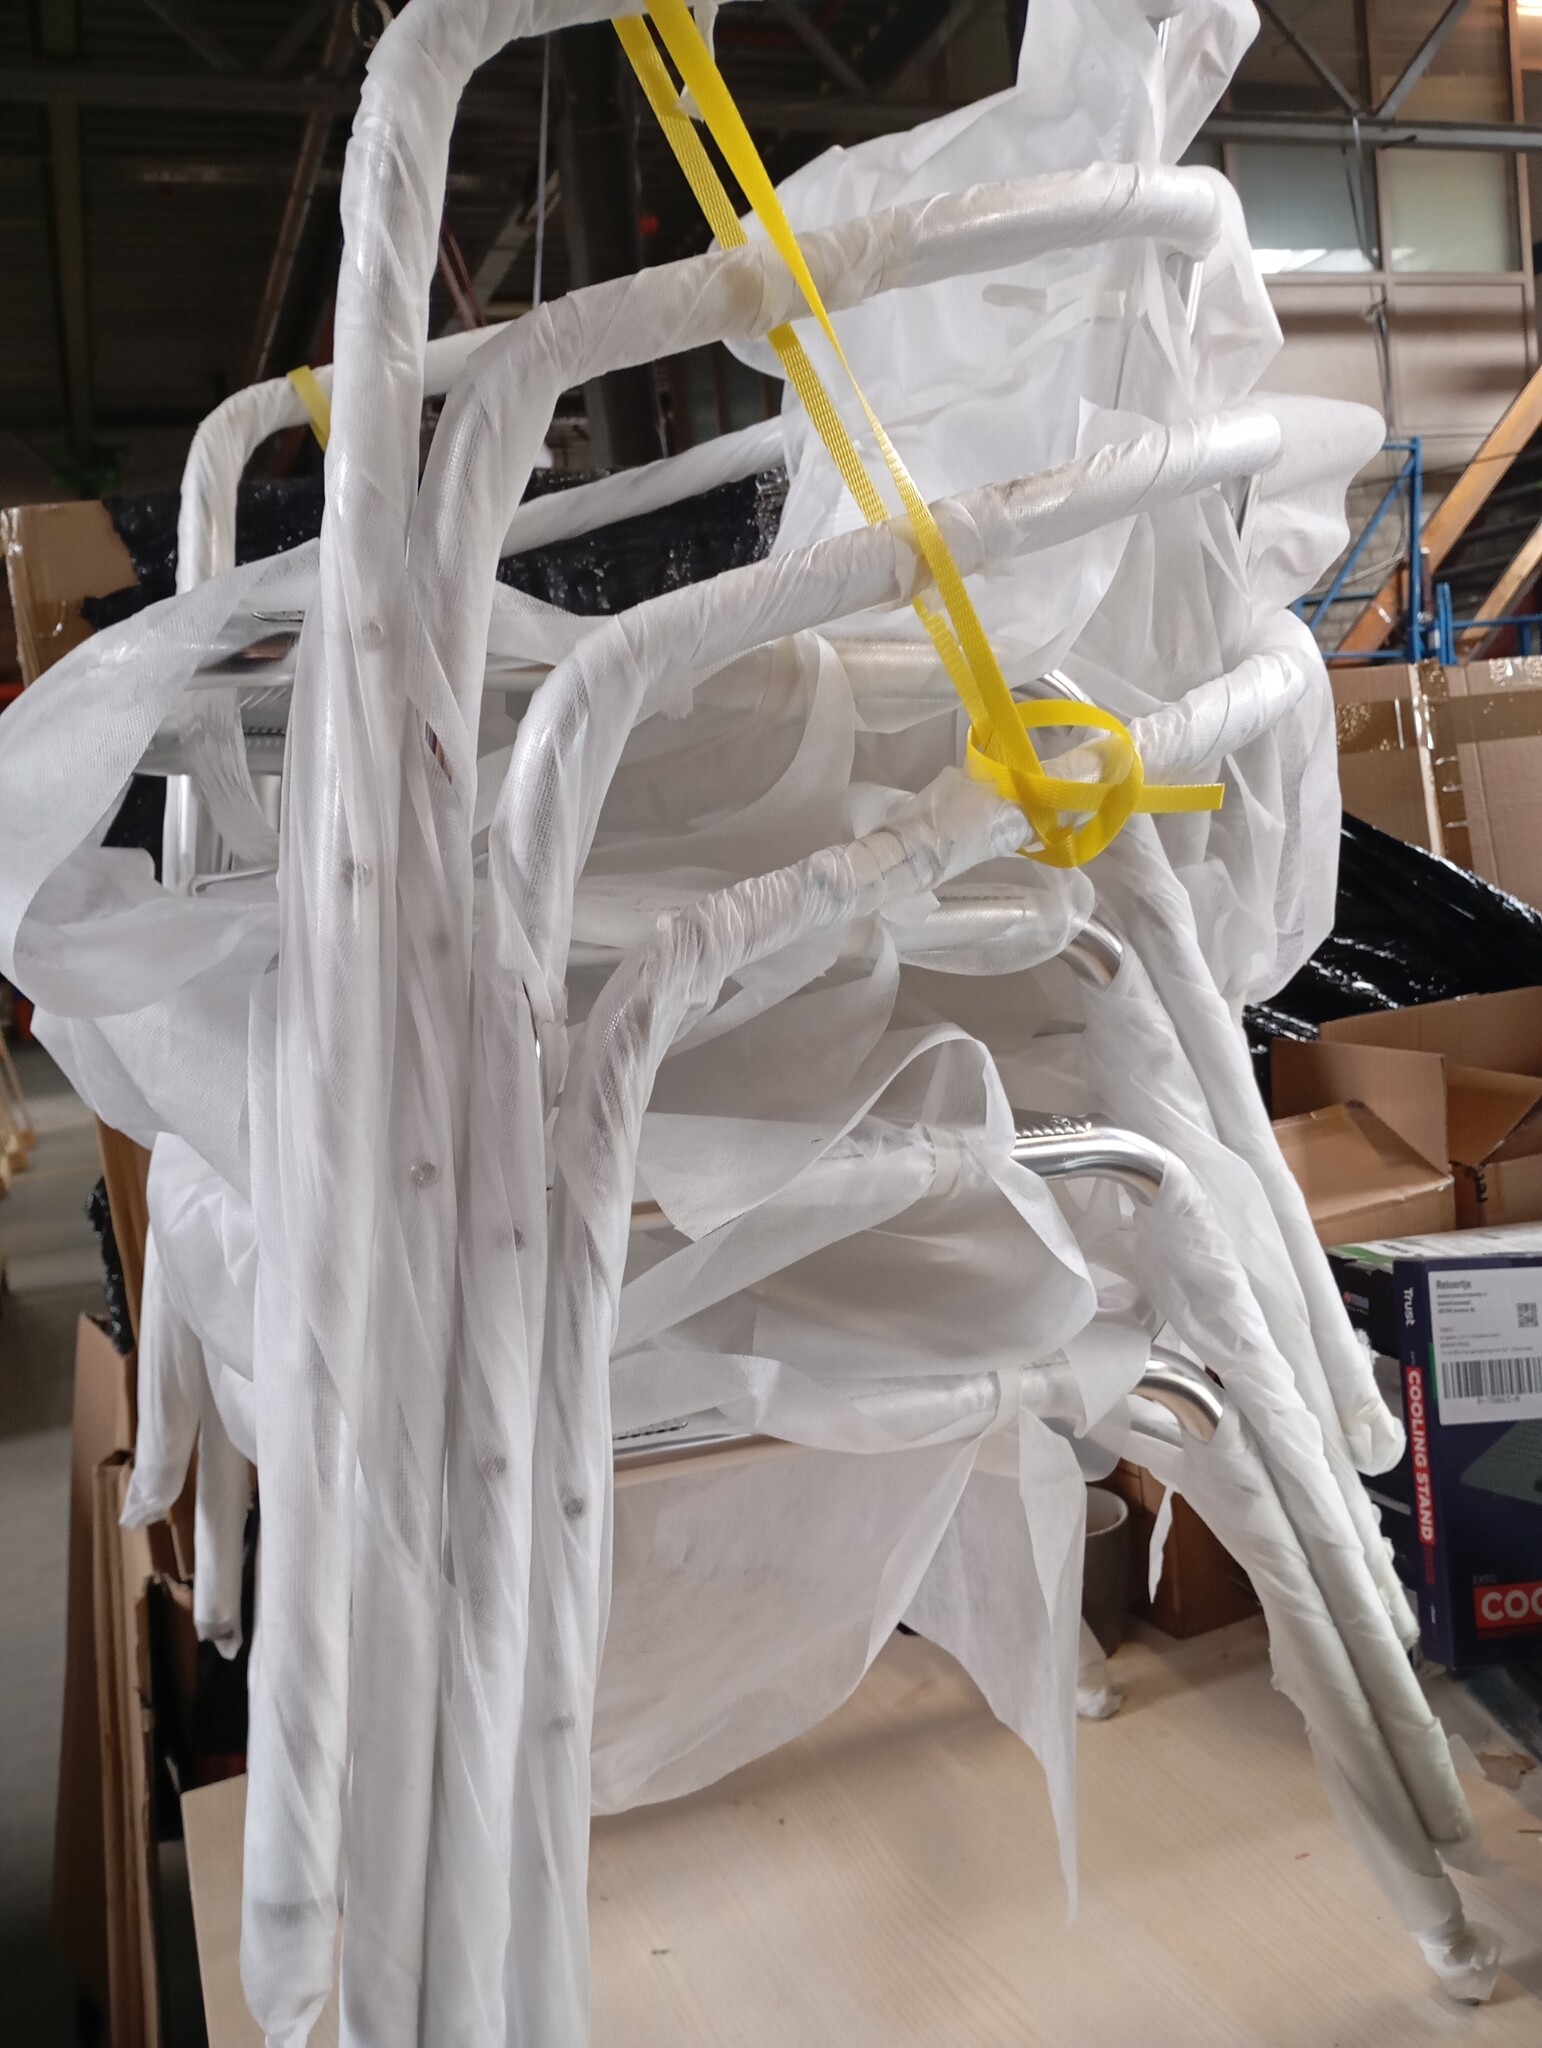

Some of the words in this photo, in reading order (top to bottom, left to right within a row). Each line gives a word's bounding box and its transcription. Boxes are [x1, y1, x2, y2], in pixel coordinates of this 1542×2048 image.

[1404, 1287, 1416, 1327] Trust
[1408, 1370, 1428, 1467] COOLING
[1416, 1471, 1434, 1541] STAND
